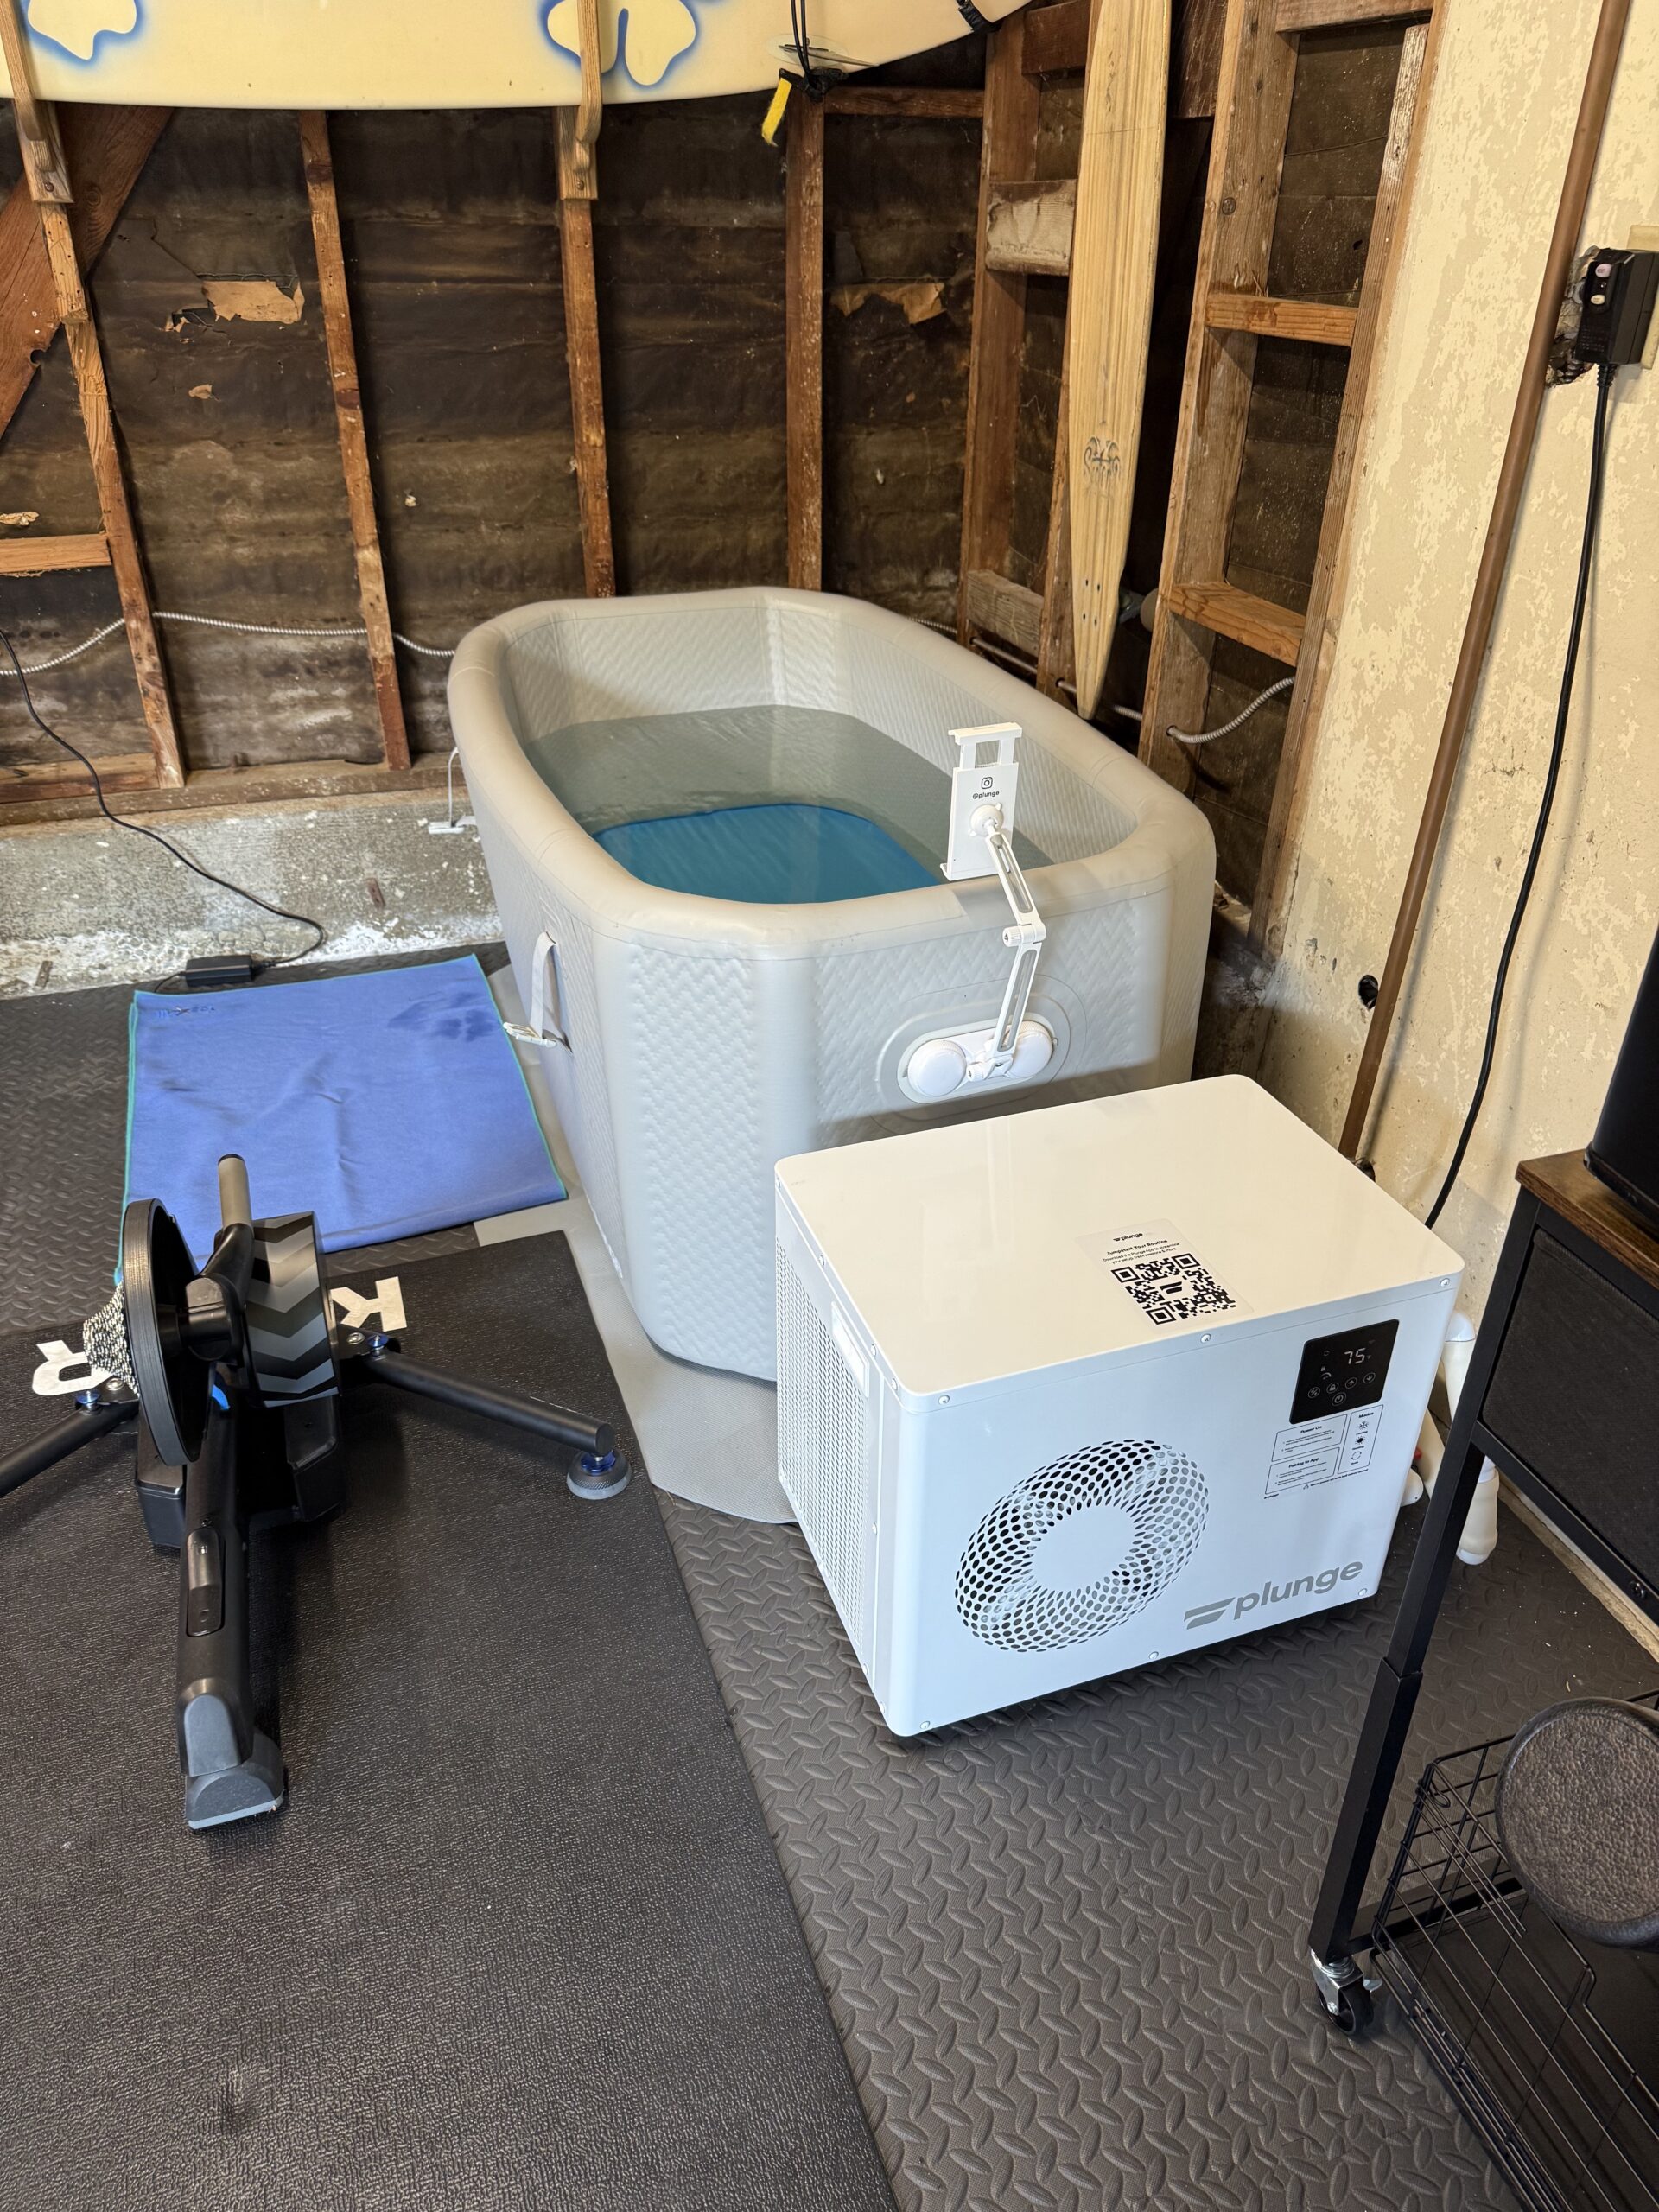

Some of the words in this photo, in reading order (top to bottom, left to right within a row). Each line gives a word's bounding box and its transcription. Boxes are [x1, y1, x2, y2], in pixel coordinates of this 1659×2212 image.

[972, 791, 1000, 799] @plunge
[1107, 1247, 1134, 1255] Jumpstart
[1344, 1348, 1366, 1365] 75
[1233, 1561, 1363, 1621] plunge
